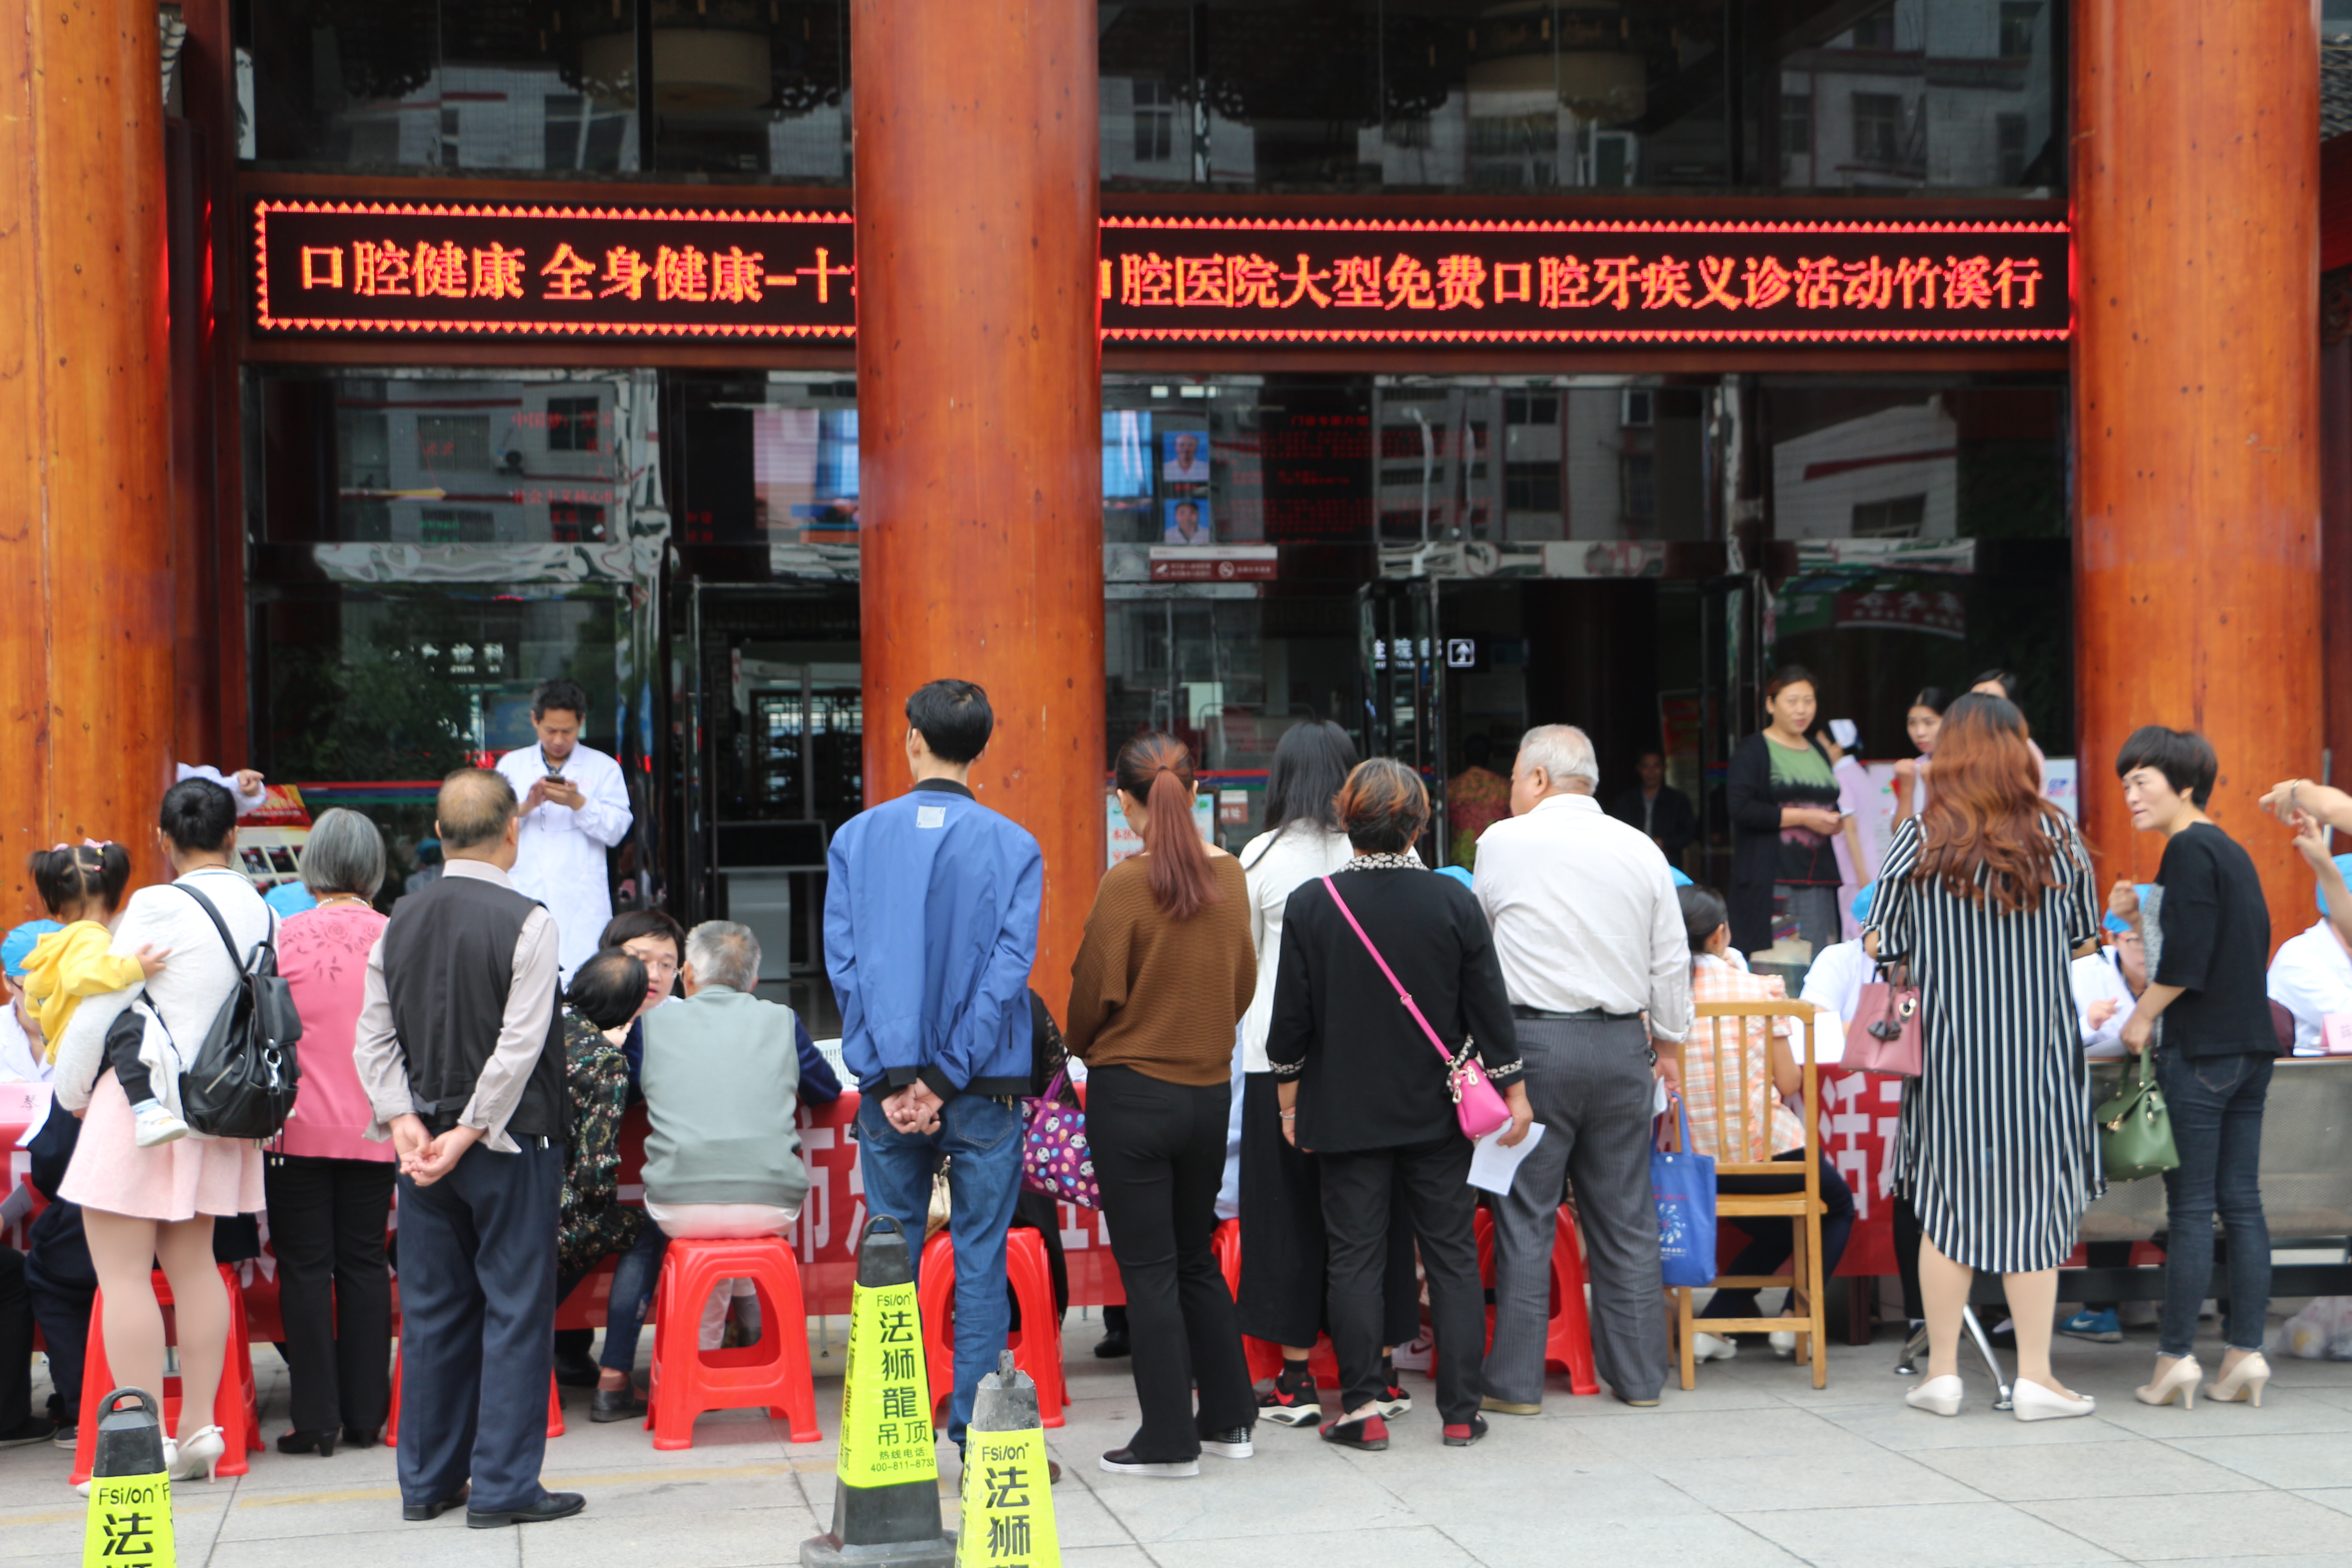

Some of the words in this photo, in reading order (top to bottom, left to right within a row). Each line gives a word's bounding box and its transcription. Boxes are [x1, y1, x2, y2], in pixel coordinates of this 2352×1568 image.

[300, 239, 525, 299] 口腔健康
[1100, 252, 2042, 311] 腔医院大型免费口腔牙疾义诊活动竹溪行
[871, 1458, 935, 1472] 400-811-8733
[102, 1512, 154, 1568] 法
[985, 1466, 1031, 1568] 法狮
